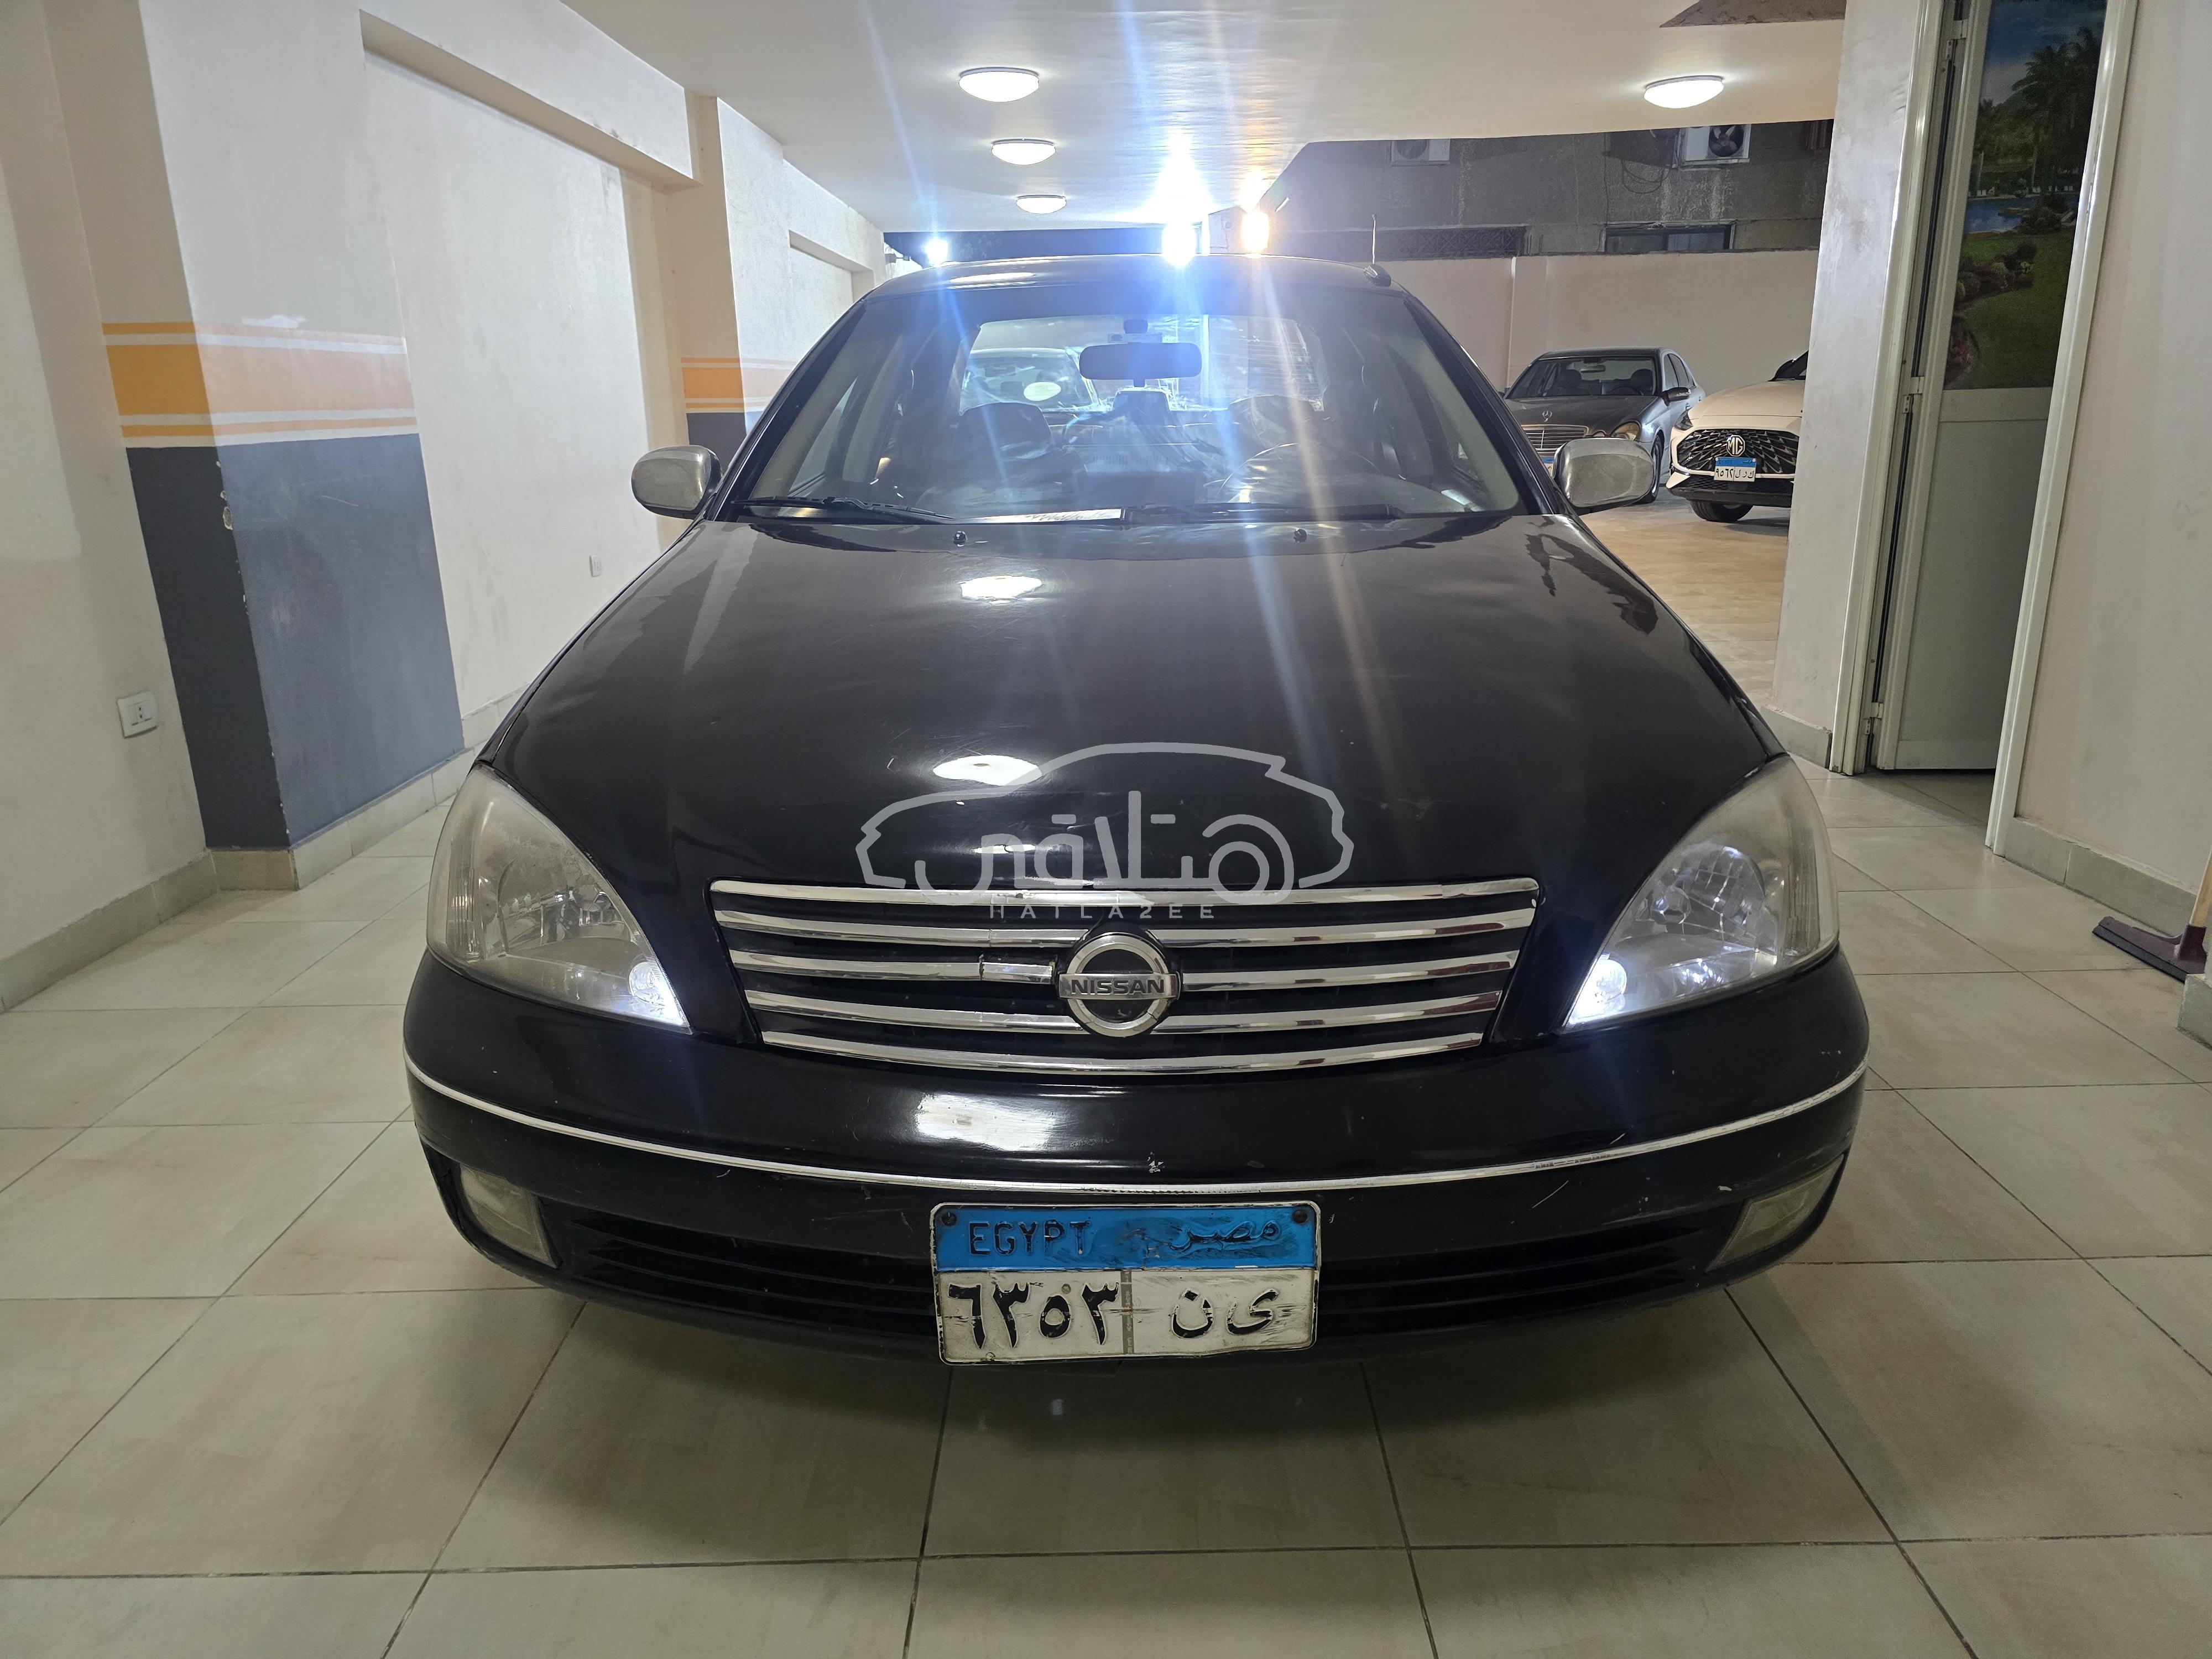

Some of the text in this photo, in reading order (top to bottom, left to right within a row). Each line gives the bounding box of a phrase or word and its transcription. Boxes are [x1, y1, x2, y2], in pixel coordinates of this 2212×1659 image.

[1727, 436, 1744, 455] MG
[1071, 979, 1165, 995] NISSAN
[968, 1220, 1091, 1256] EGYPT
[1168, 1220, 1280, 1254] مصر
[949, 1282, 1119, 1348] ٦٣٥٣
